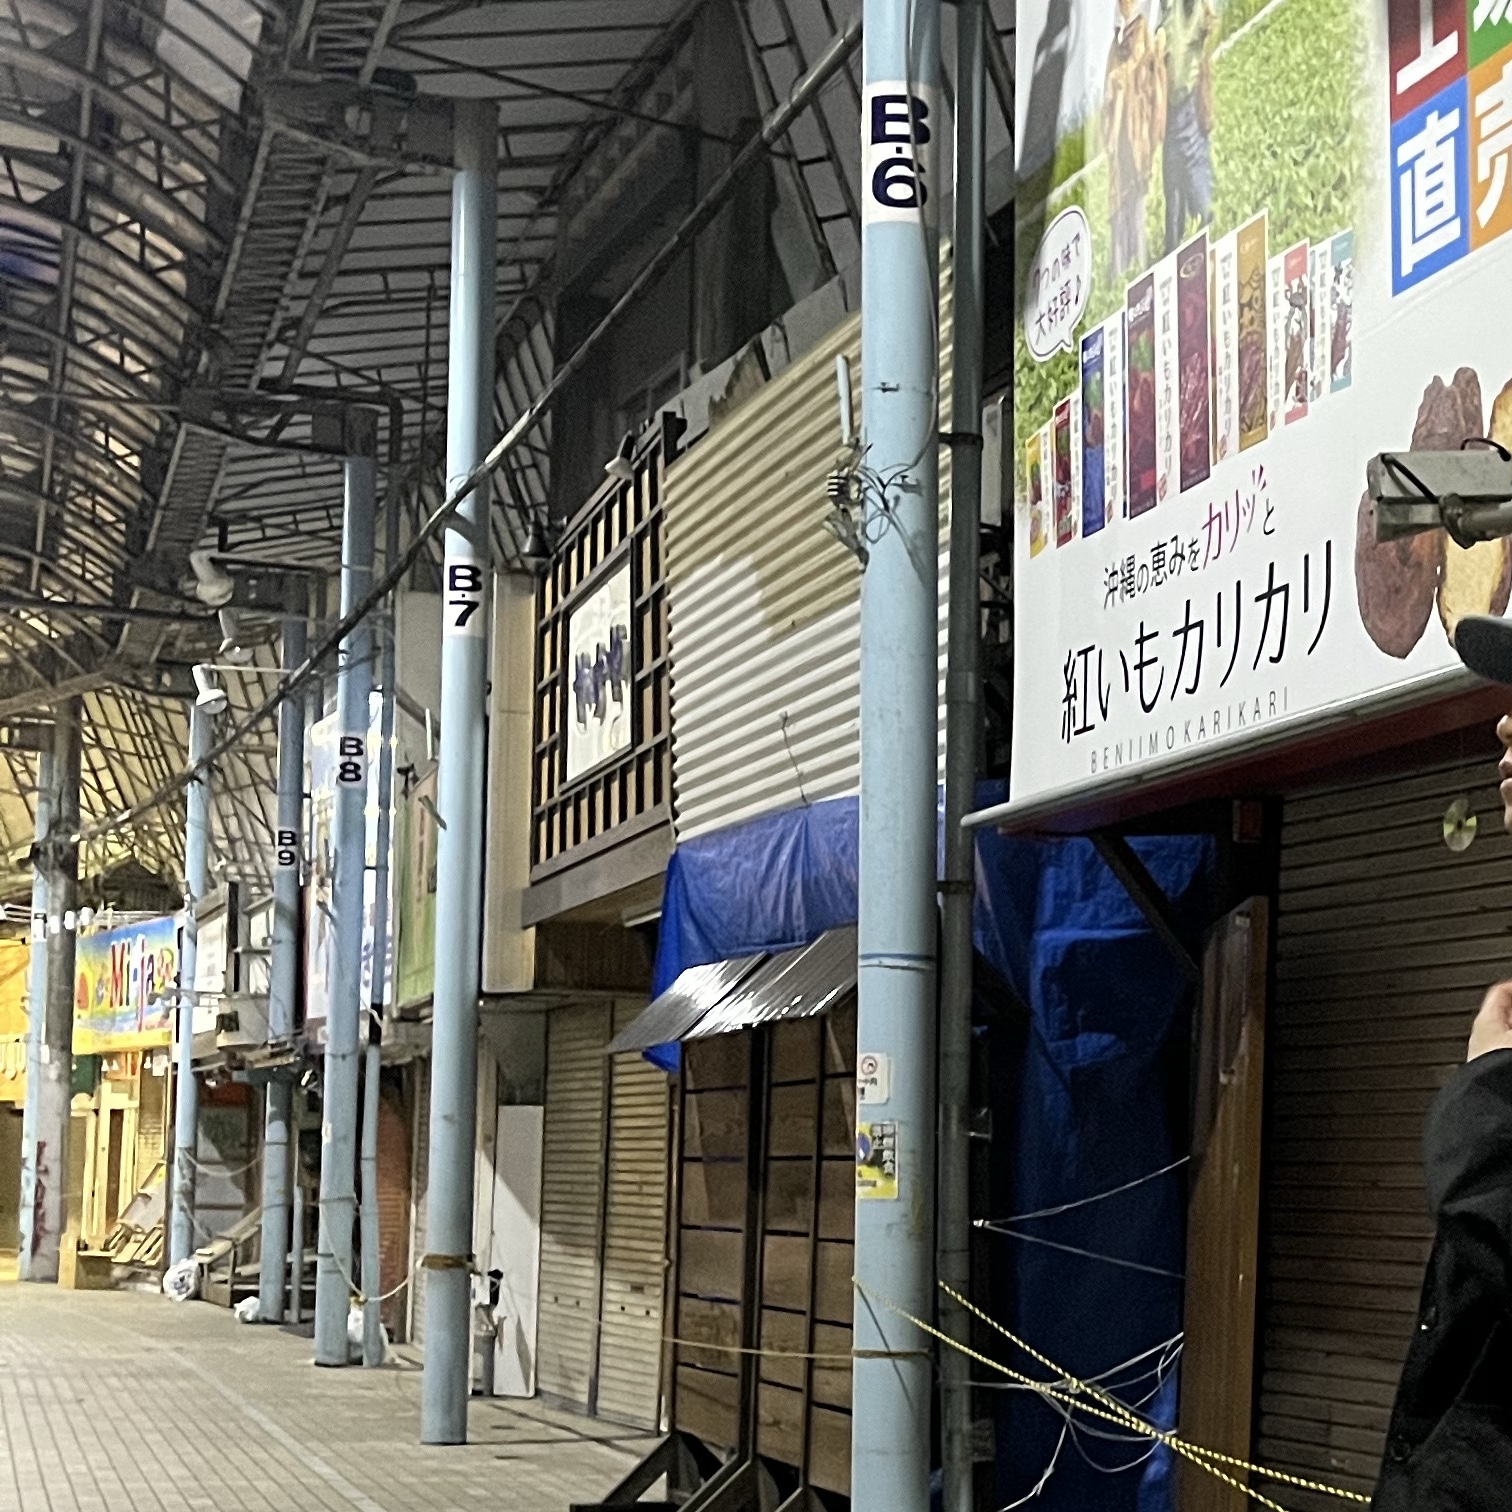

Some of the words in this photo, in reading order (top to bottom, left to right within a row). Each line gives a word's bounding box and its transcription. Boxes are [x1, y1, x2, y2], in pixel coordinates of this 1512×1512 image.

[1104, 489, 1275, 610] 沖縄の恵みをカリッと
[1062, 540, 1332, 744] 紅いもカリカリ
